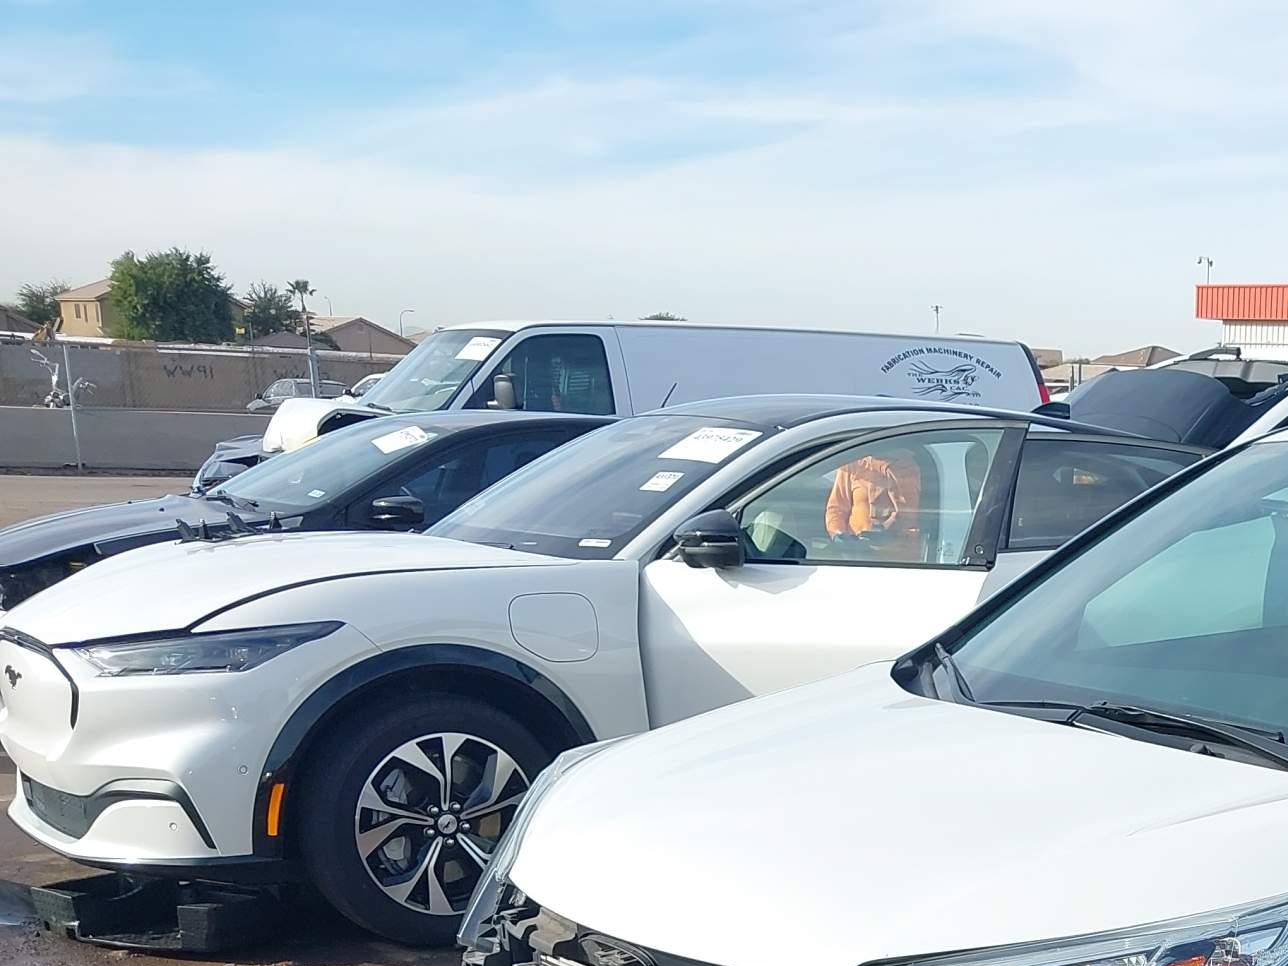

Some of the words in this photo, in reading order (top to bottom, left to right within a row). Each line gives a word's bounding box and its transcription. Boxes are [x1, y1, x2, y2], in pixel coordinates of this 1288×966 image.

[880, 347, 925, 374] FABRICATION
[925, 347, 974, 361] MACHINERY
[975, 358, 1002, 380] REPAIR
